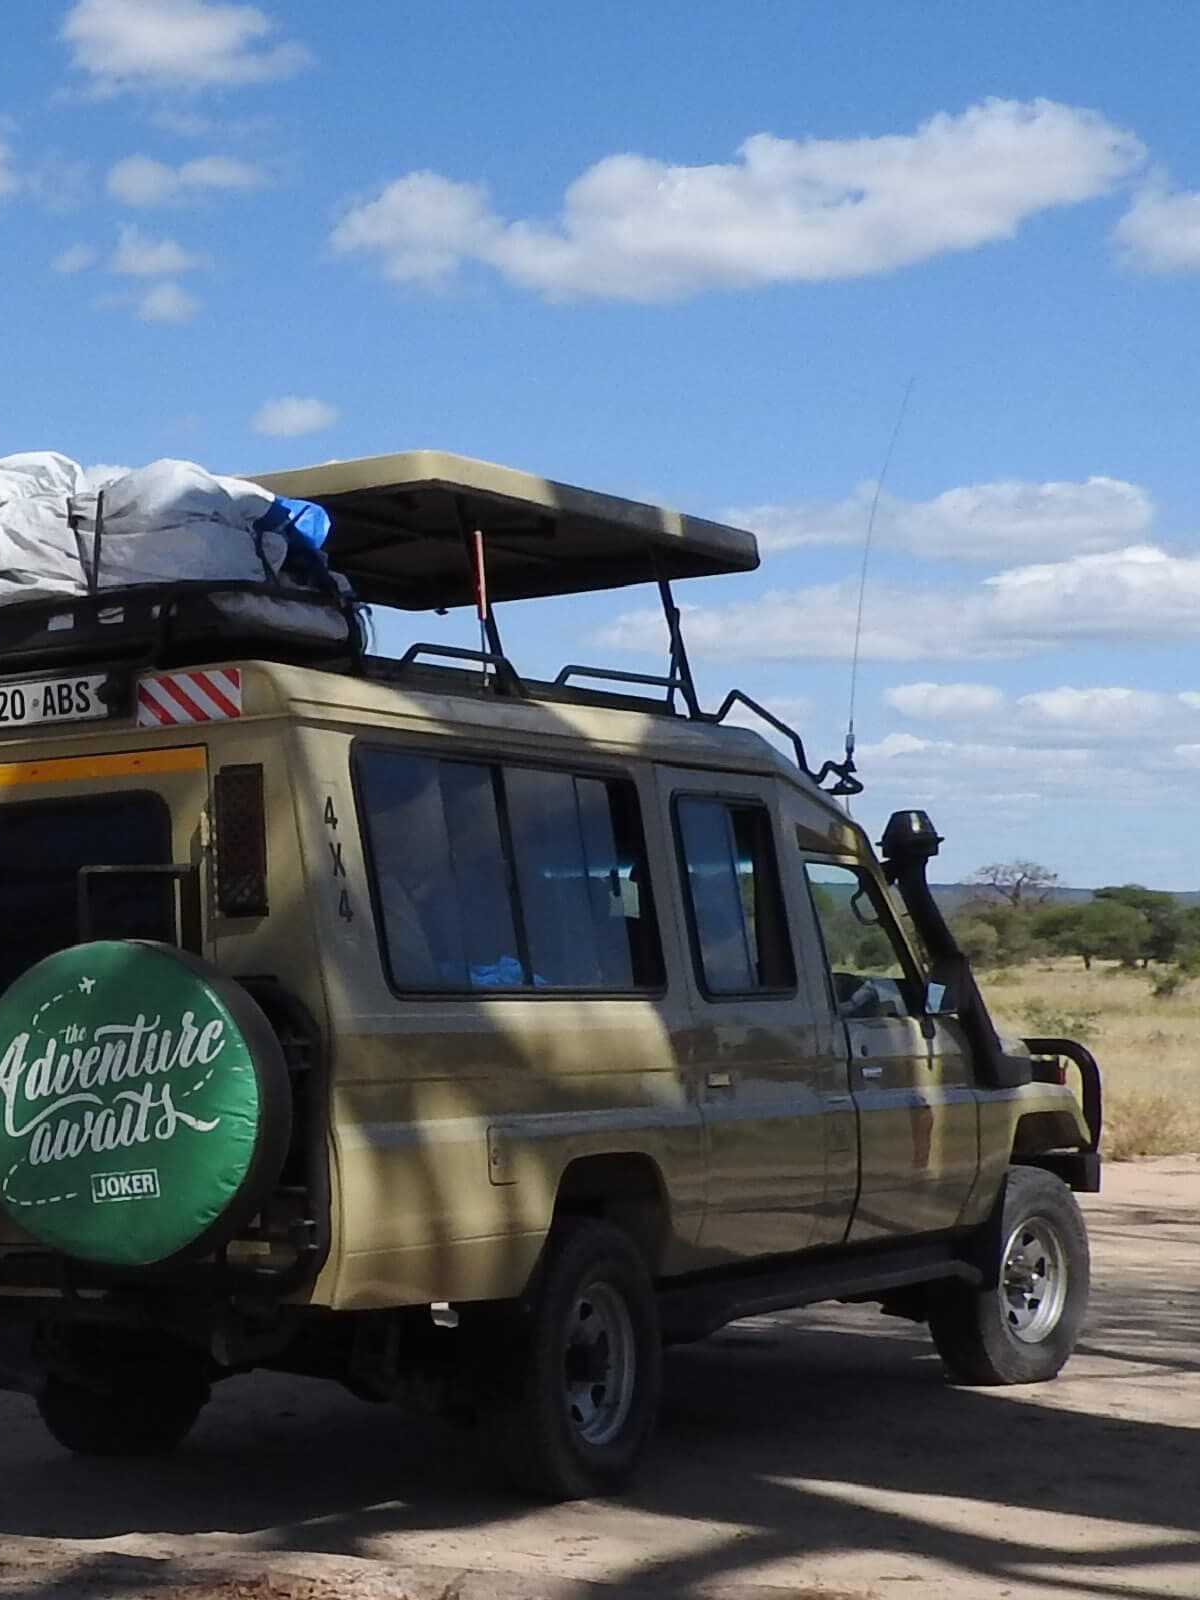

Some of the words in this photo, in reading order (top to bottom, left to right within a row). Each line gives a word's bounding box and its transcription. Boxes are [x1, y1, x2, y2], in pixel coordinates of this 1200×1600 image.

[42, 681, 91, 717] ABS
[59, 1022, 87, 1045] the
[29, 1082, 221, 1166] awaits
[96, 1174, 155, 1198] JOKER
